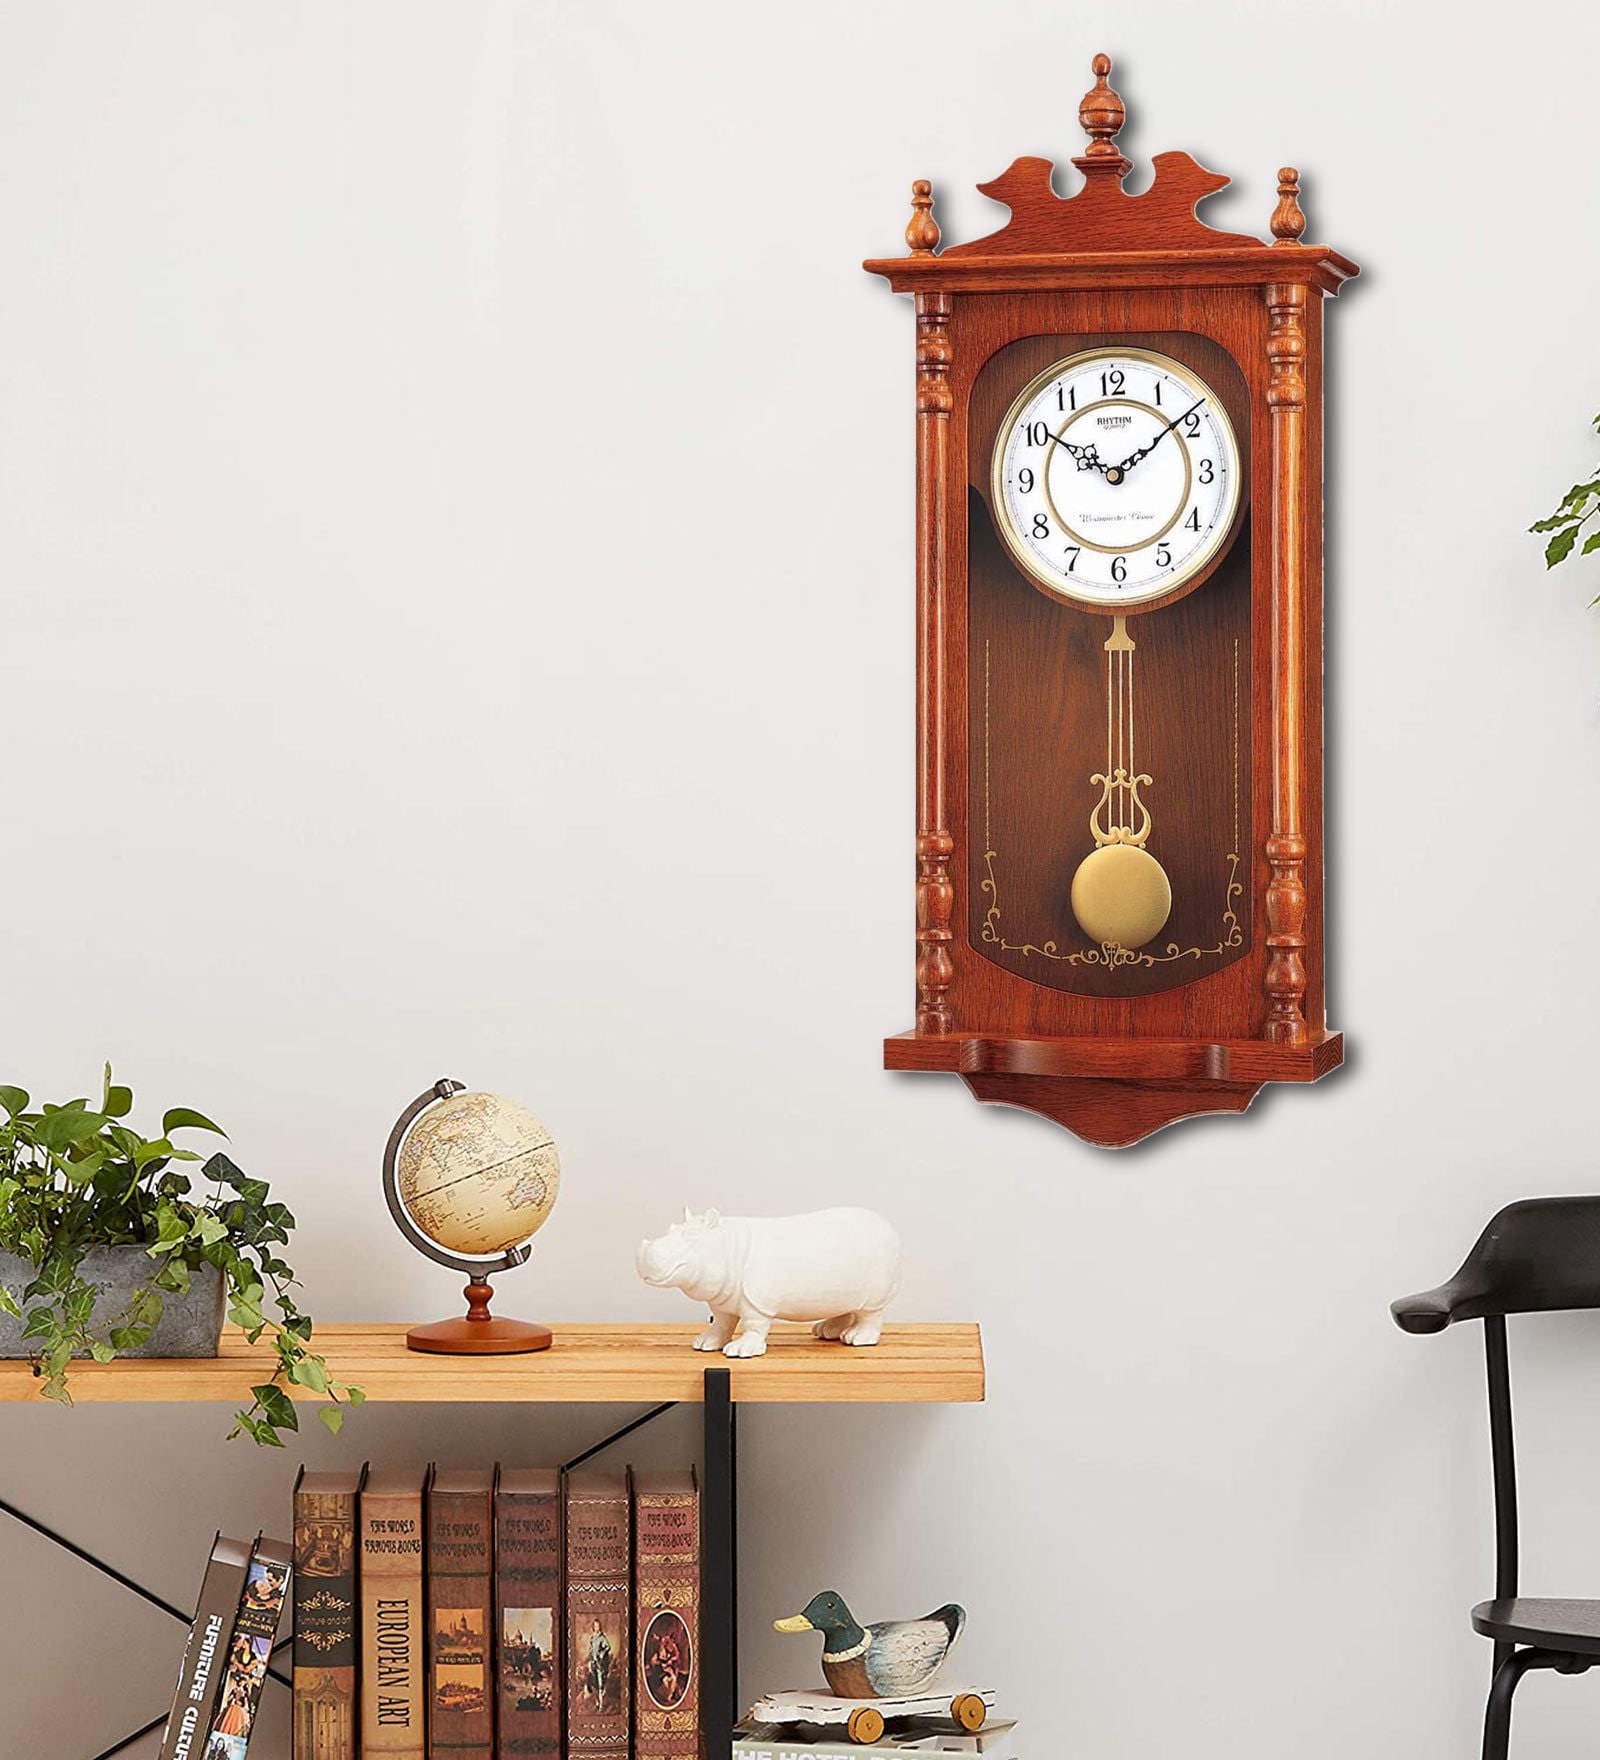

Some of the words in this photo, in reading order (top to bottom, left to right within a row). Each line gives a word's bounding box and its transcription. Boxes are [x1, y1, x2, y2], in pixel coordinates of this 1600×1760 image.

[1100, 370, 1126, 396] 12
[1153, 381, 1162, 406] 1
[1057, 385, 1076, 411] 11
[1025, 421, 1048, 447] 10
[1096, 416, 1132, 426] RHYTHM
[1185, 413, 1201, 438] 2
[1018, 468, 1034, 494] 9
[1198, 459, 1214, 484] 3
[1032, 513, 1050, 539] 8
[1184, 506, 1202, 532] 4
[1064, 546, 1080, 572] 7
[1156, 542, 1171, 567] 5
[1111, 556, 1127, 582] 6
[377, 1599, 410, 1687] EUROPEAN
[189, 1614, 223, 1701] FURNITURE
[378, 1695, 410, 1727] ART
